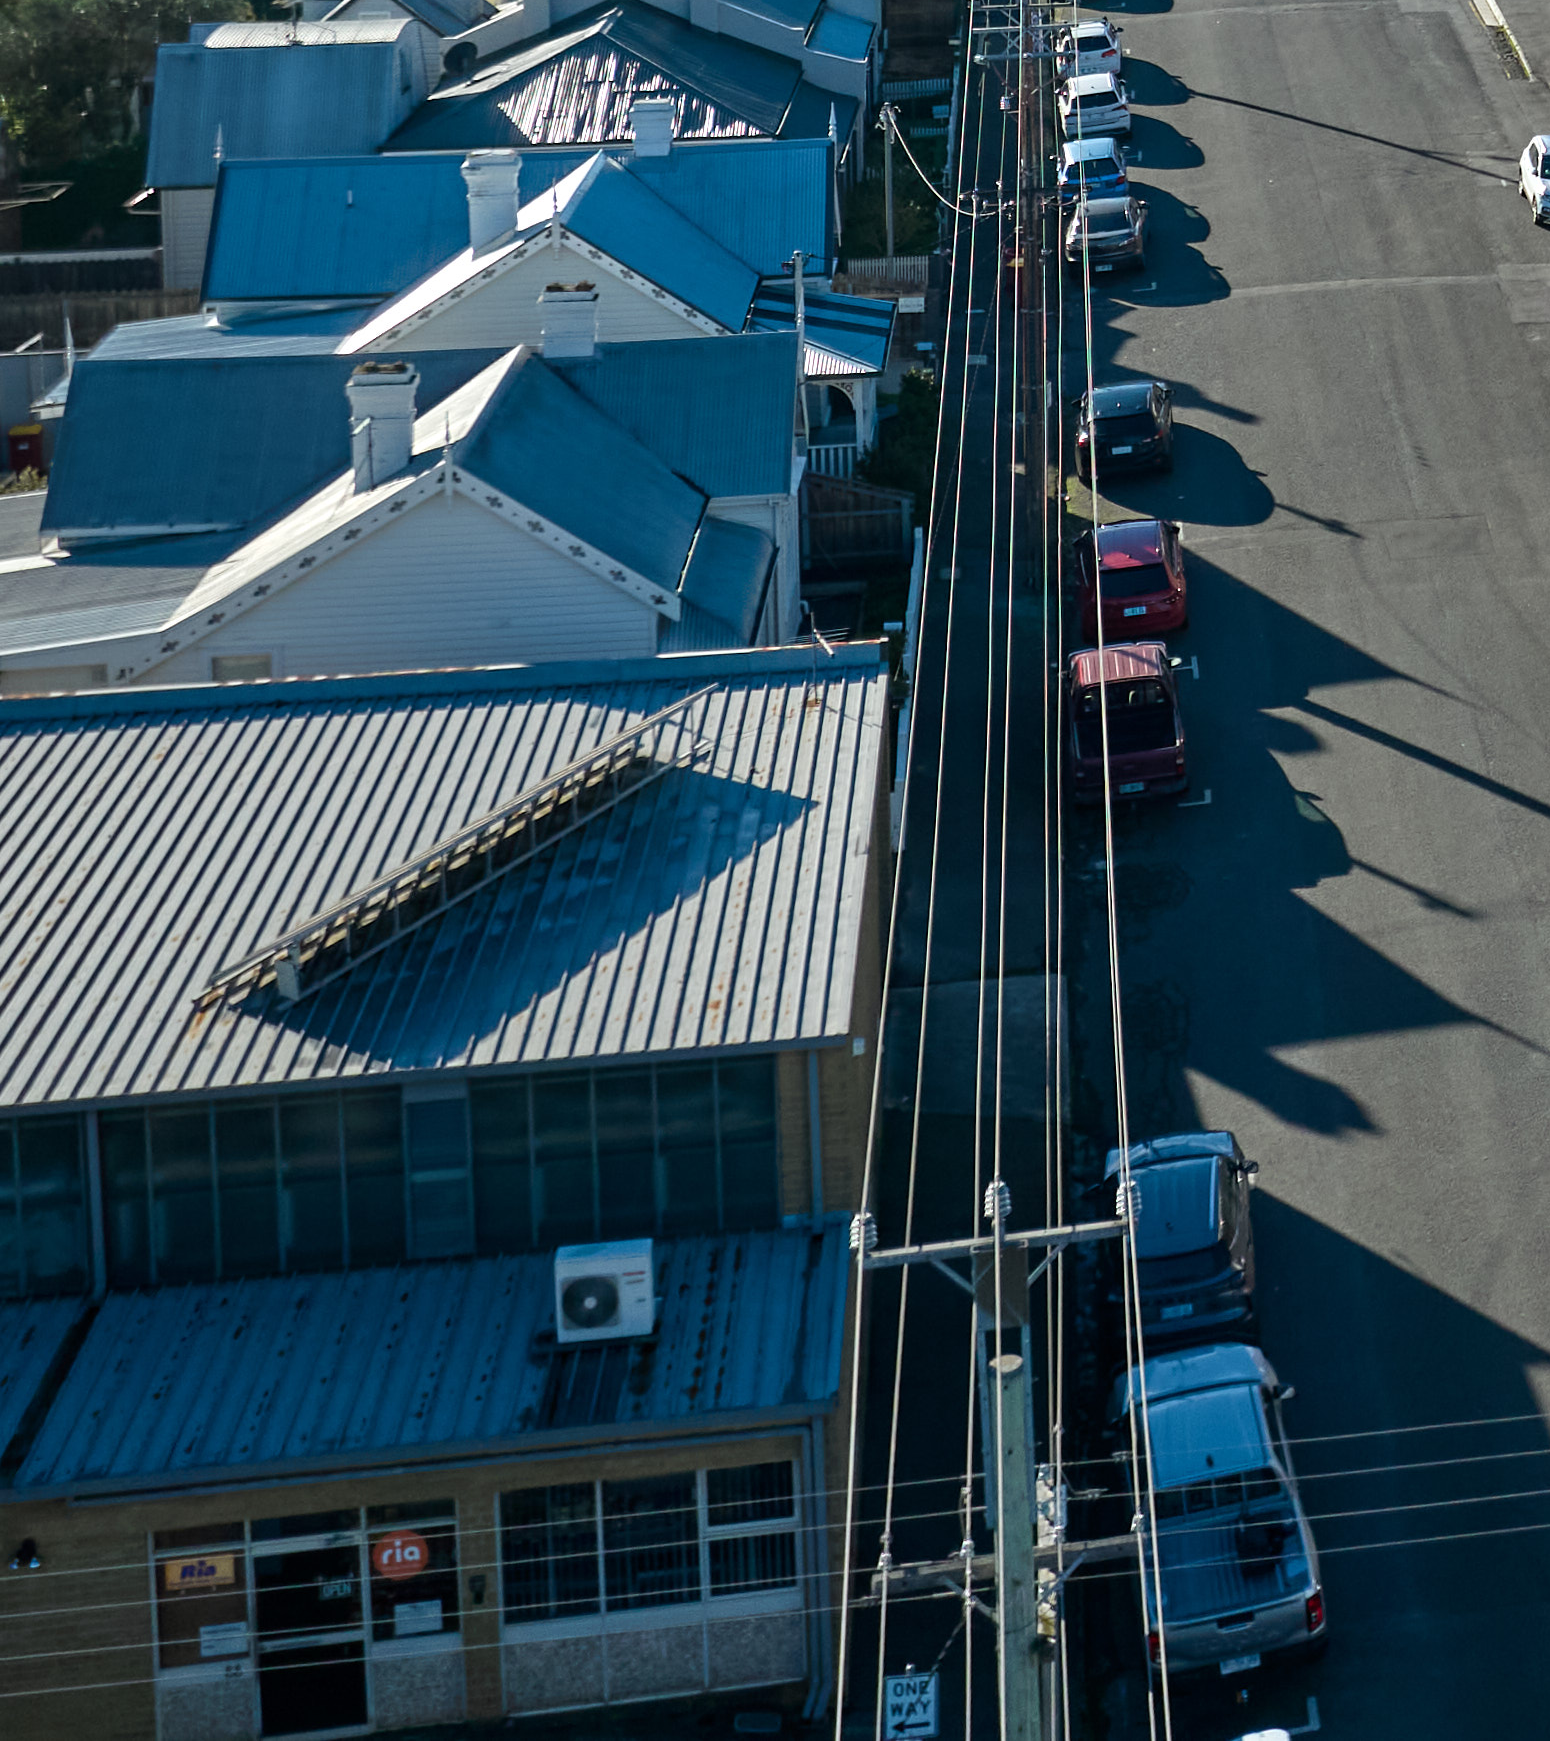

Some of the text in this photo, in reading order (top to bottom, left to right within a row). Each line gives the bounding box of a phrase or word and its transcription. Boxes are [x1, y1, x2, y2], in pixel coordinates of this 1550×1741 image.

[382, 1539, 421, 1564] ria
[181, 1560, 217, 1579] Ria
[893, 1680, 930, 1697] ONE
[890, 1700, 932, 1718] WAY
